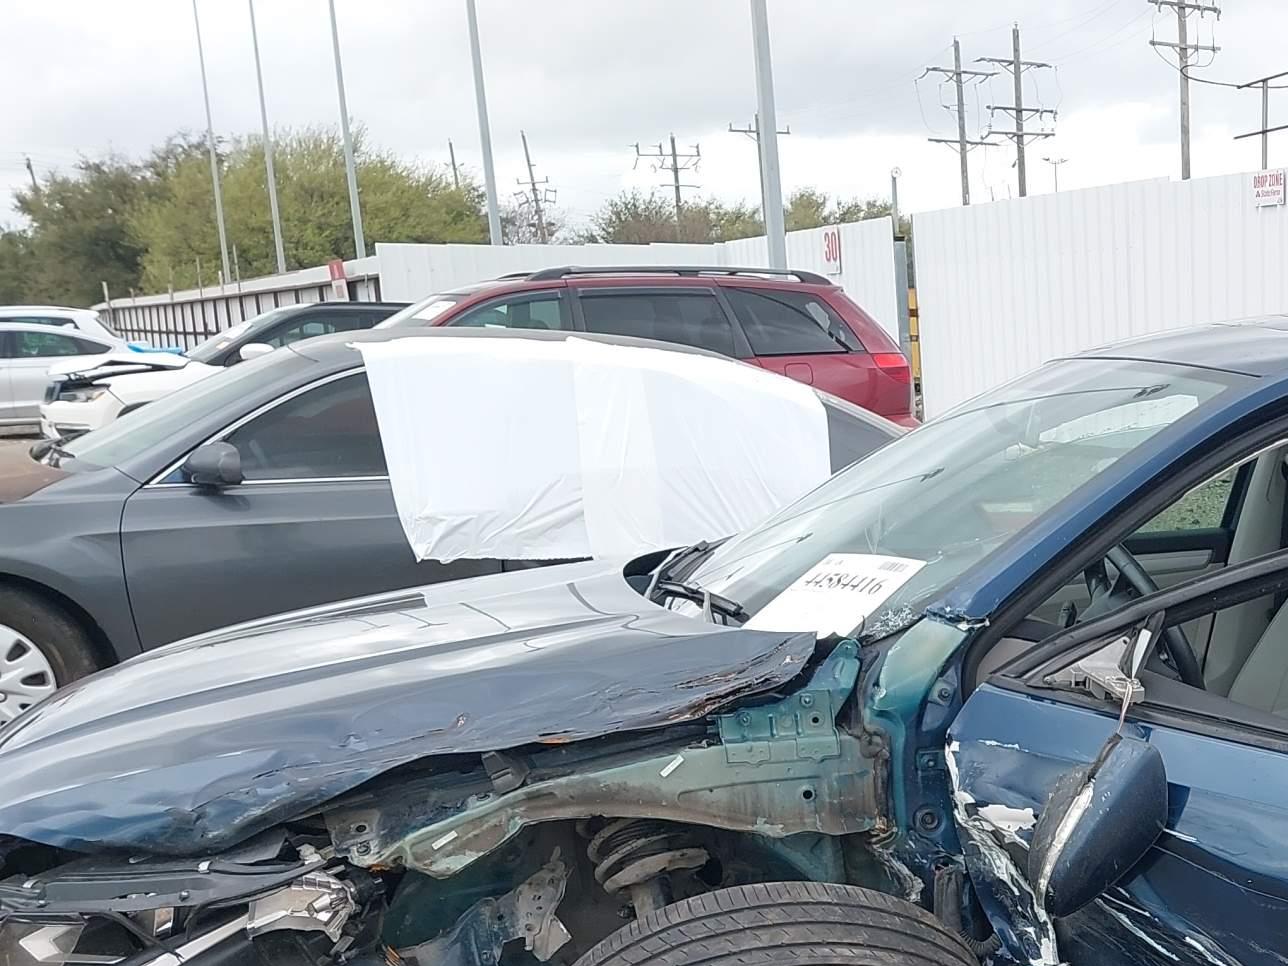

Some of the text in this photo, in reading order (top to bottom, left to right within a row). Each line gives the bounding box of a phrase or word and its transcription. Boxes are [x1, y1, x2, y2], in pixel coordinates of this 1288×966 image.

[1253, 172, 1283, 189] DROP ZONE
[824, 231, 838, 262] 30
